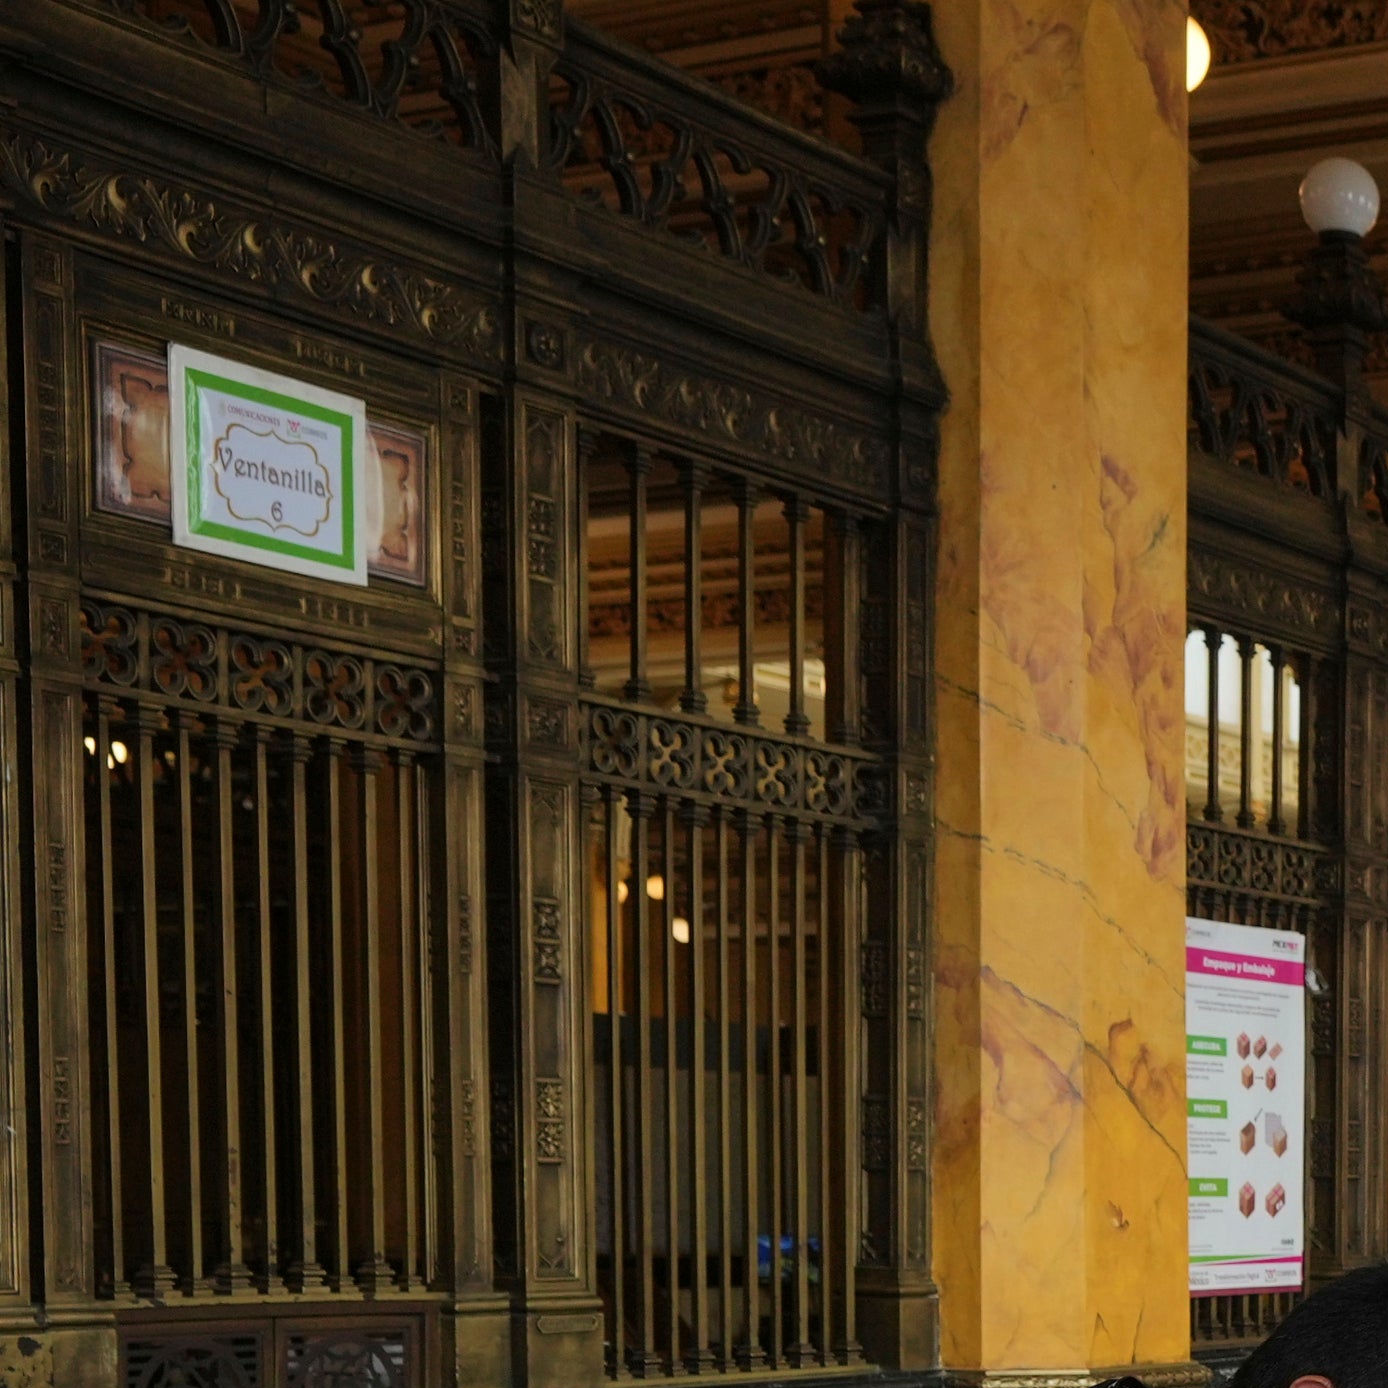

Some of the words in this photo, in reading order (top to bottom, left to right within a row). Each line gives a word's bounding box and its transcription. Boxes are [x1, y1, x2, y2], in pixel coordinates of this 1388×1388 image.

[218, 446, 326, 498] Ventanilla
[270, 501, 283, 522] 6
[1203, 956, 1236, 973] Empaque
[1243, 962, 1275, 978] Embalaje
